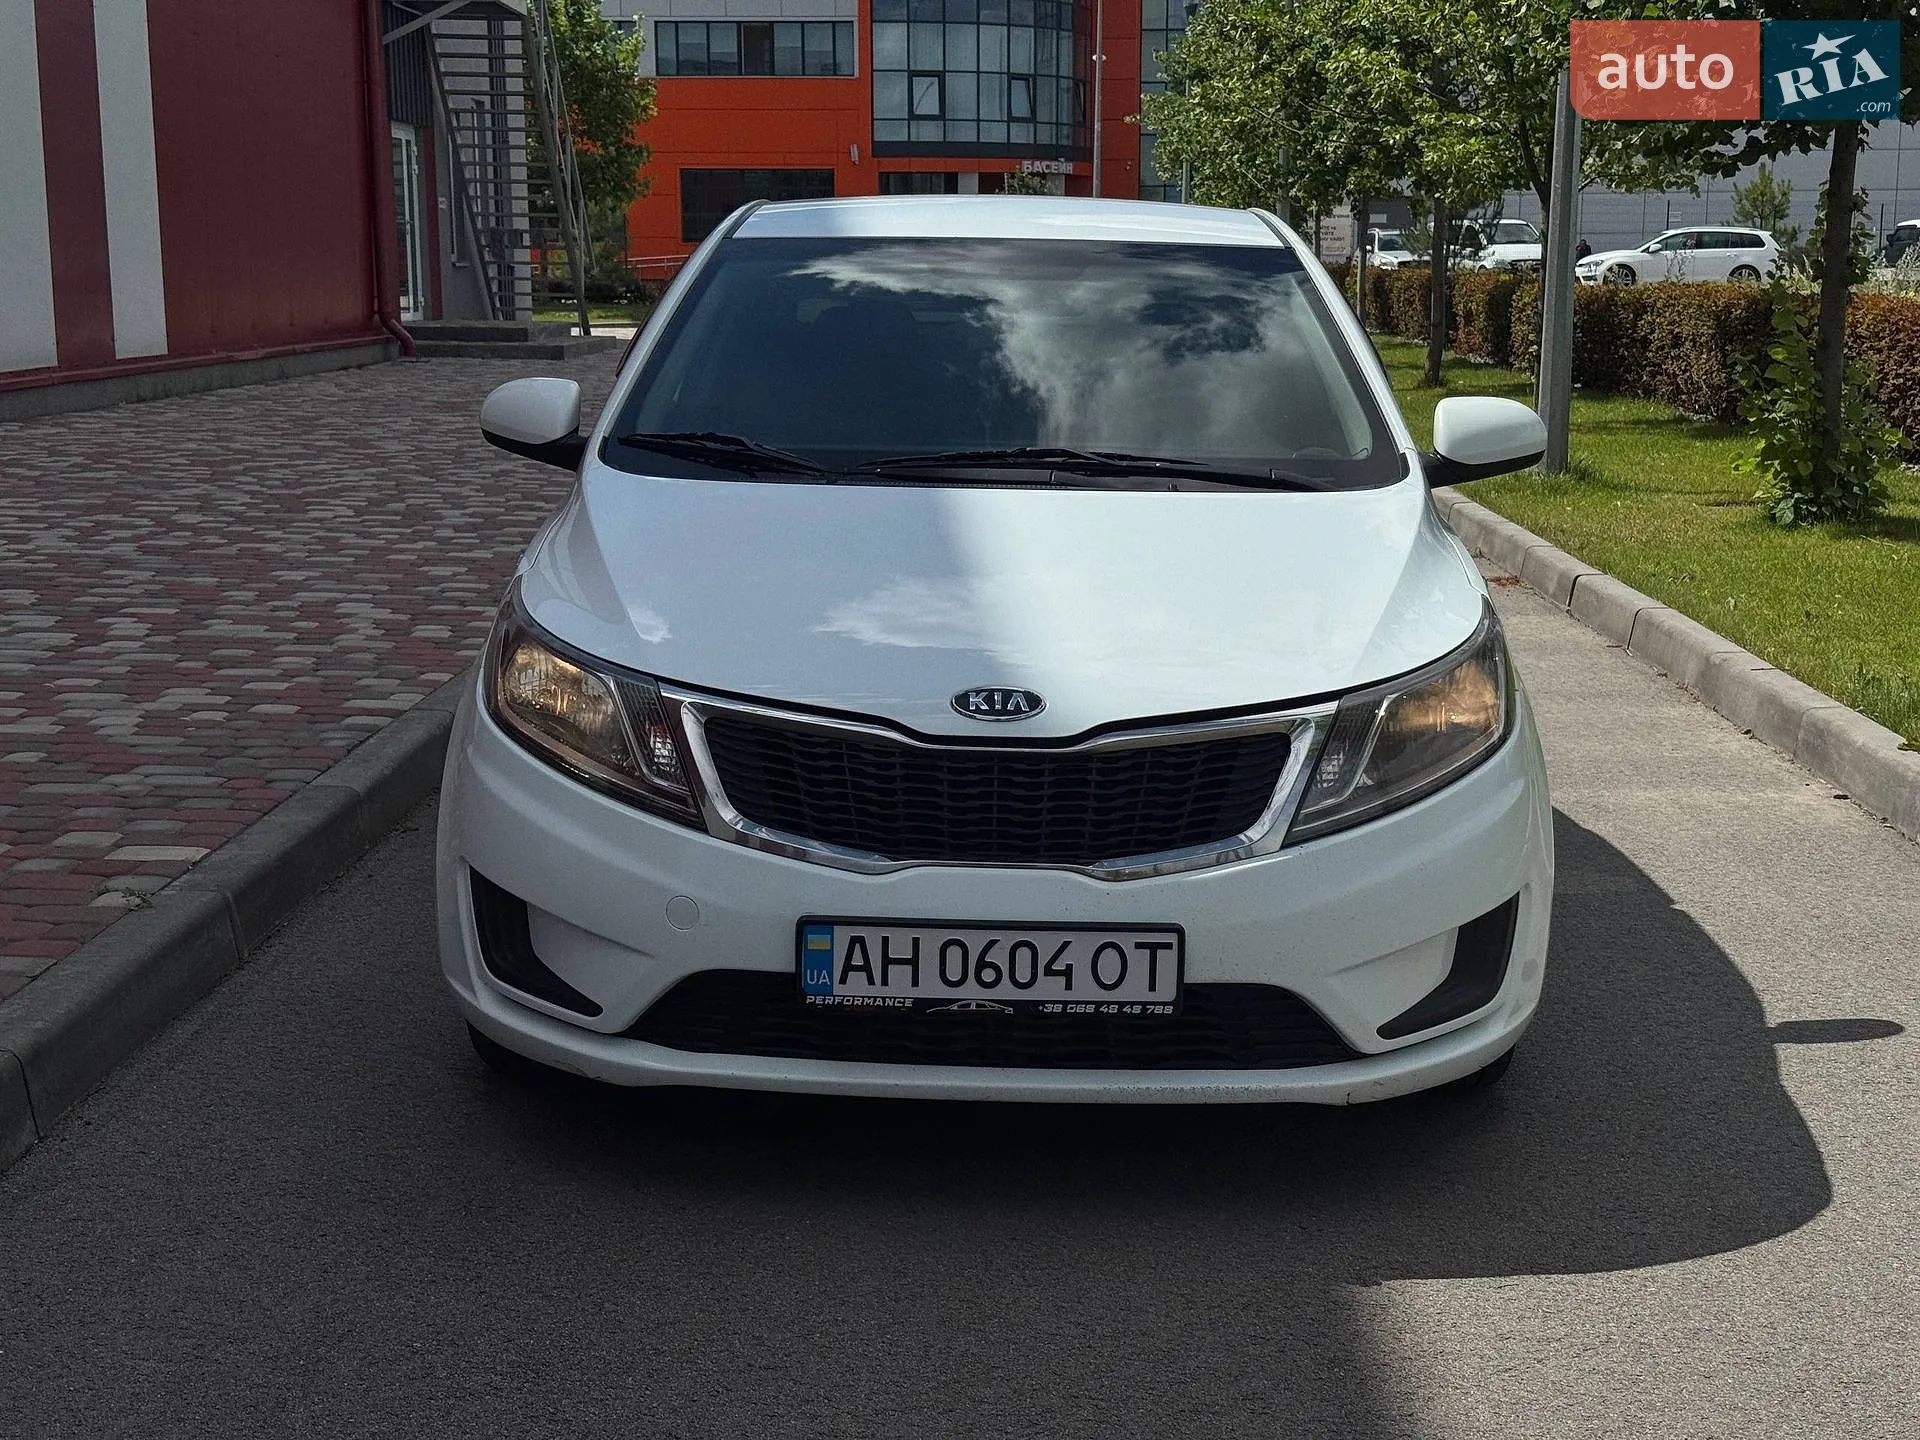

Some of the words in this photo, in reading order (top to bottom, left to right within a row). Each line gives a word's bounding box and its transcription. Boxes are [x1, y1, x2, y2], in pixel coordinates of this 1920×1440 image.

[967, 691, 1030, 712] KIA
[838, 934, 921, 988] AH
[938, 937, 1074, 992] 0604
[1090, 940, 1174, 993] OT
[806, 969, 831, 985] UA
[805, 995, 914, 1008] PERFORMANCE
[1037, 1003, 1063, 1014] +38
[1099, 1004, 1118, 1014] 48
[1122, 1004, 1142, 1014] 48
